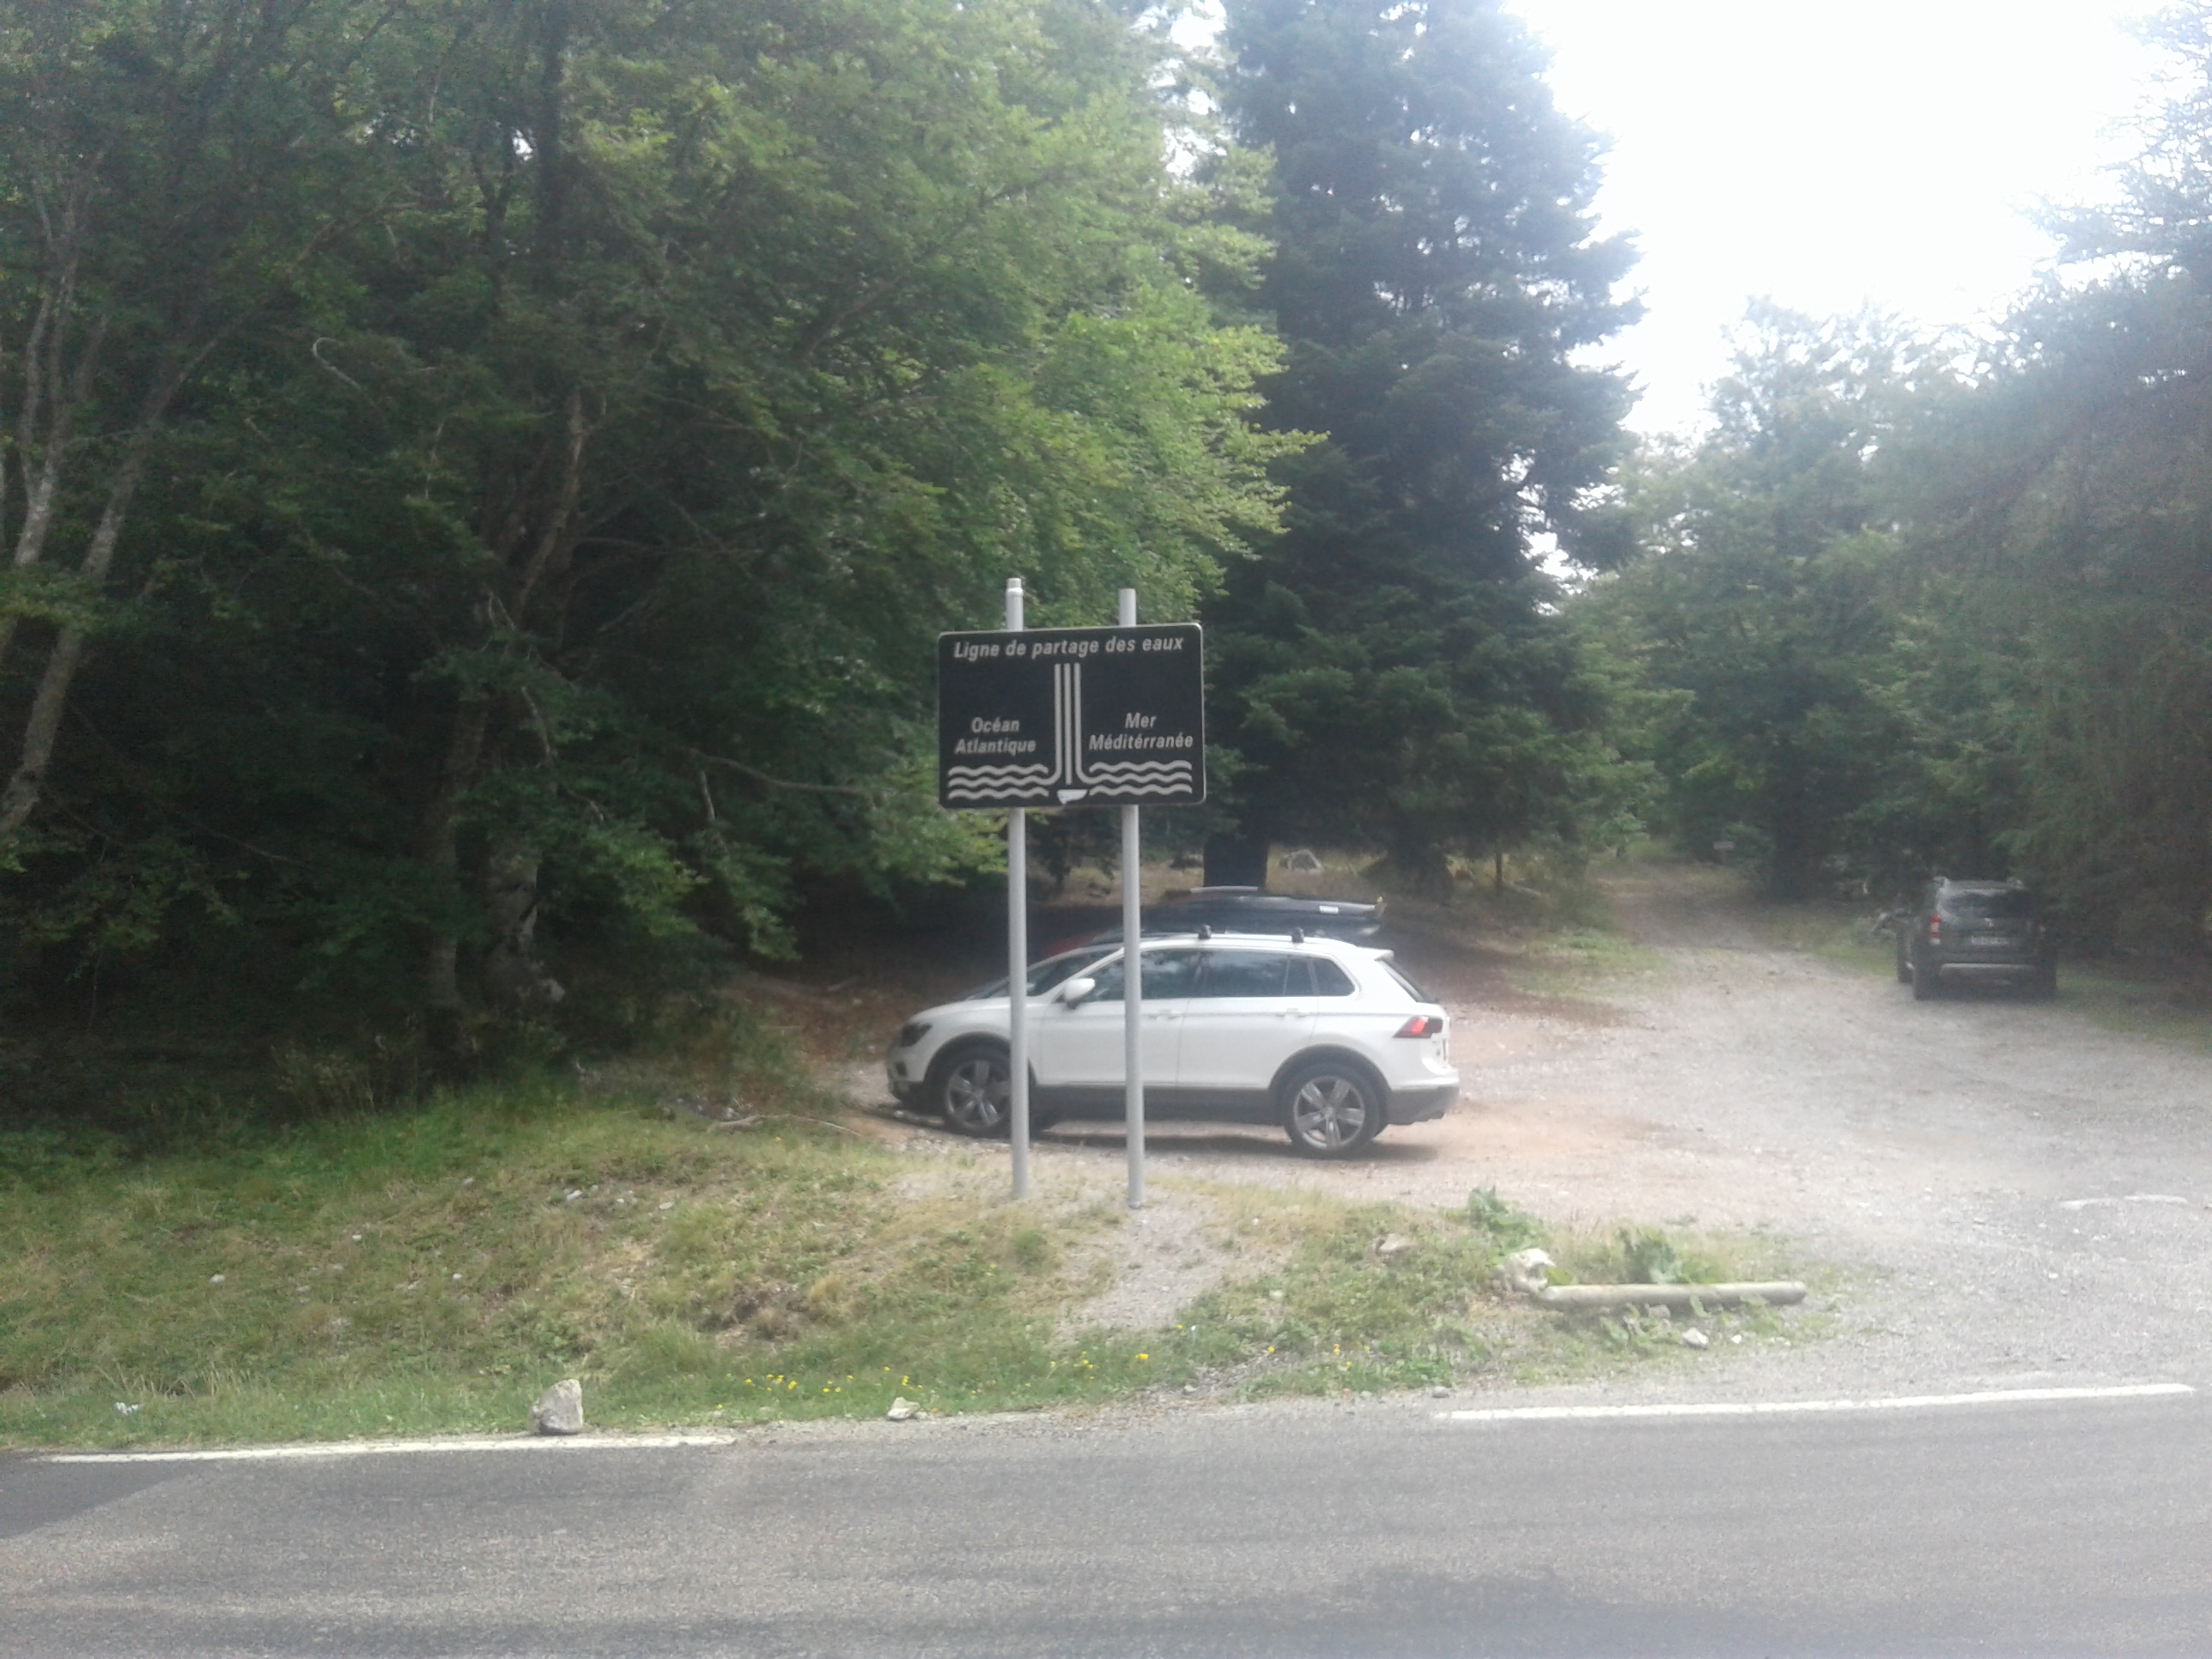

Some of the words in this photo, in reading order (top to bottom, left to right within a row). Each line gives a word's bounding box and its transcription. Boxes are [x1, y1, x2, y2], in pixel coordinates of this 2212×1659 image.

[953, 641, 1000, 661] Ligne
[1005, 640, 1026, 656] de
[1031, 639, 1099, 659] partage
[1105, 635, 1136, 652] des
[1142, 637, 1184, 650] eaux
[970, 716, 1020, 733] Océan
[1124, 712, 1157, 729] Mer
[953, 738, 1036, 757] Atlantique
[1088, 732, 1194, 751] Méditérranée
